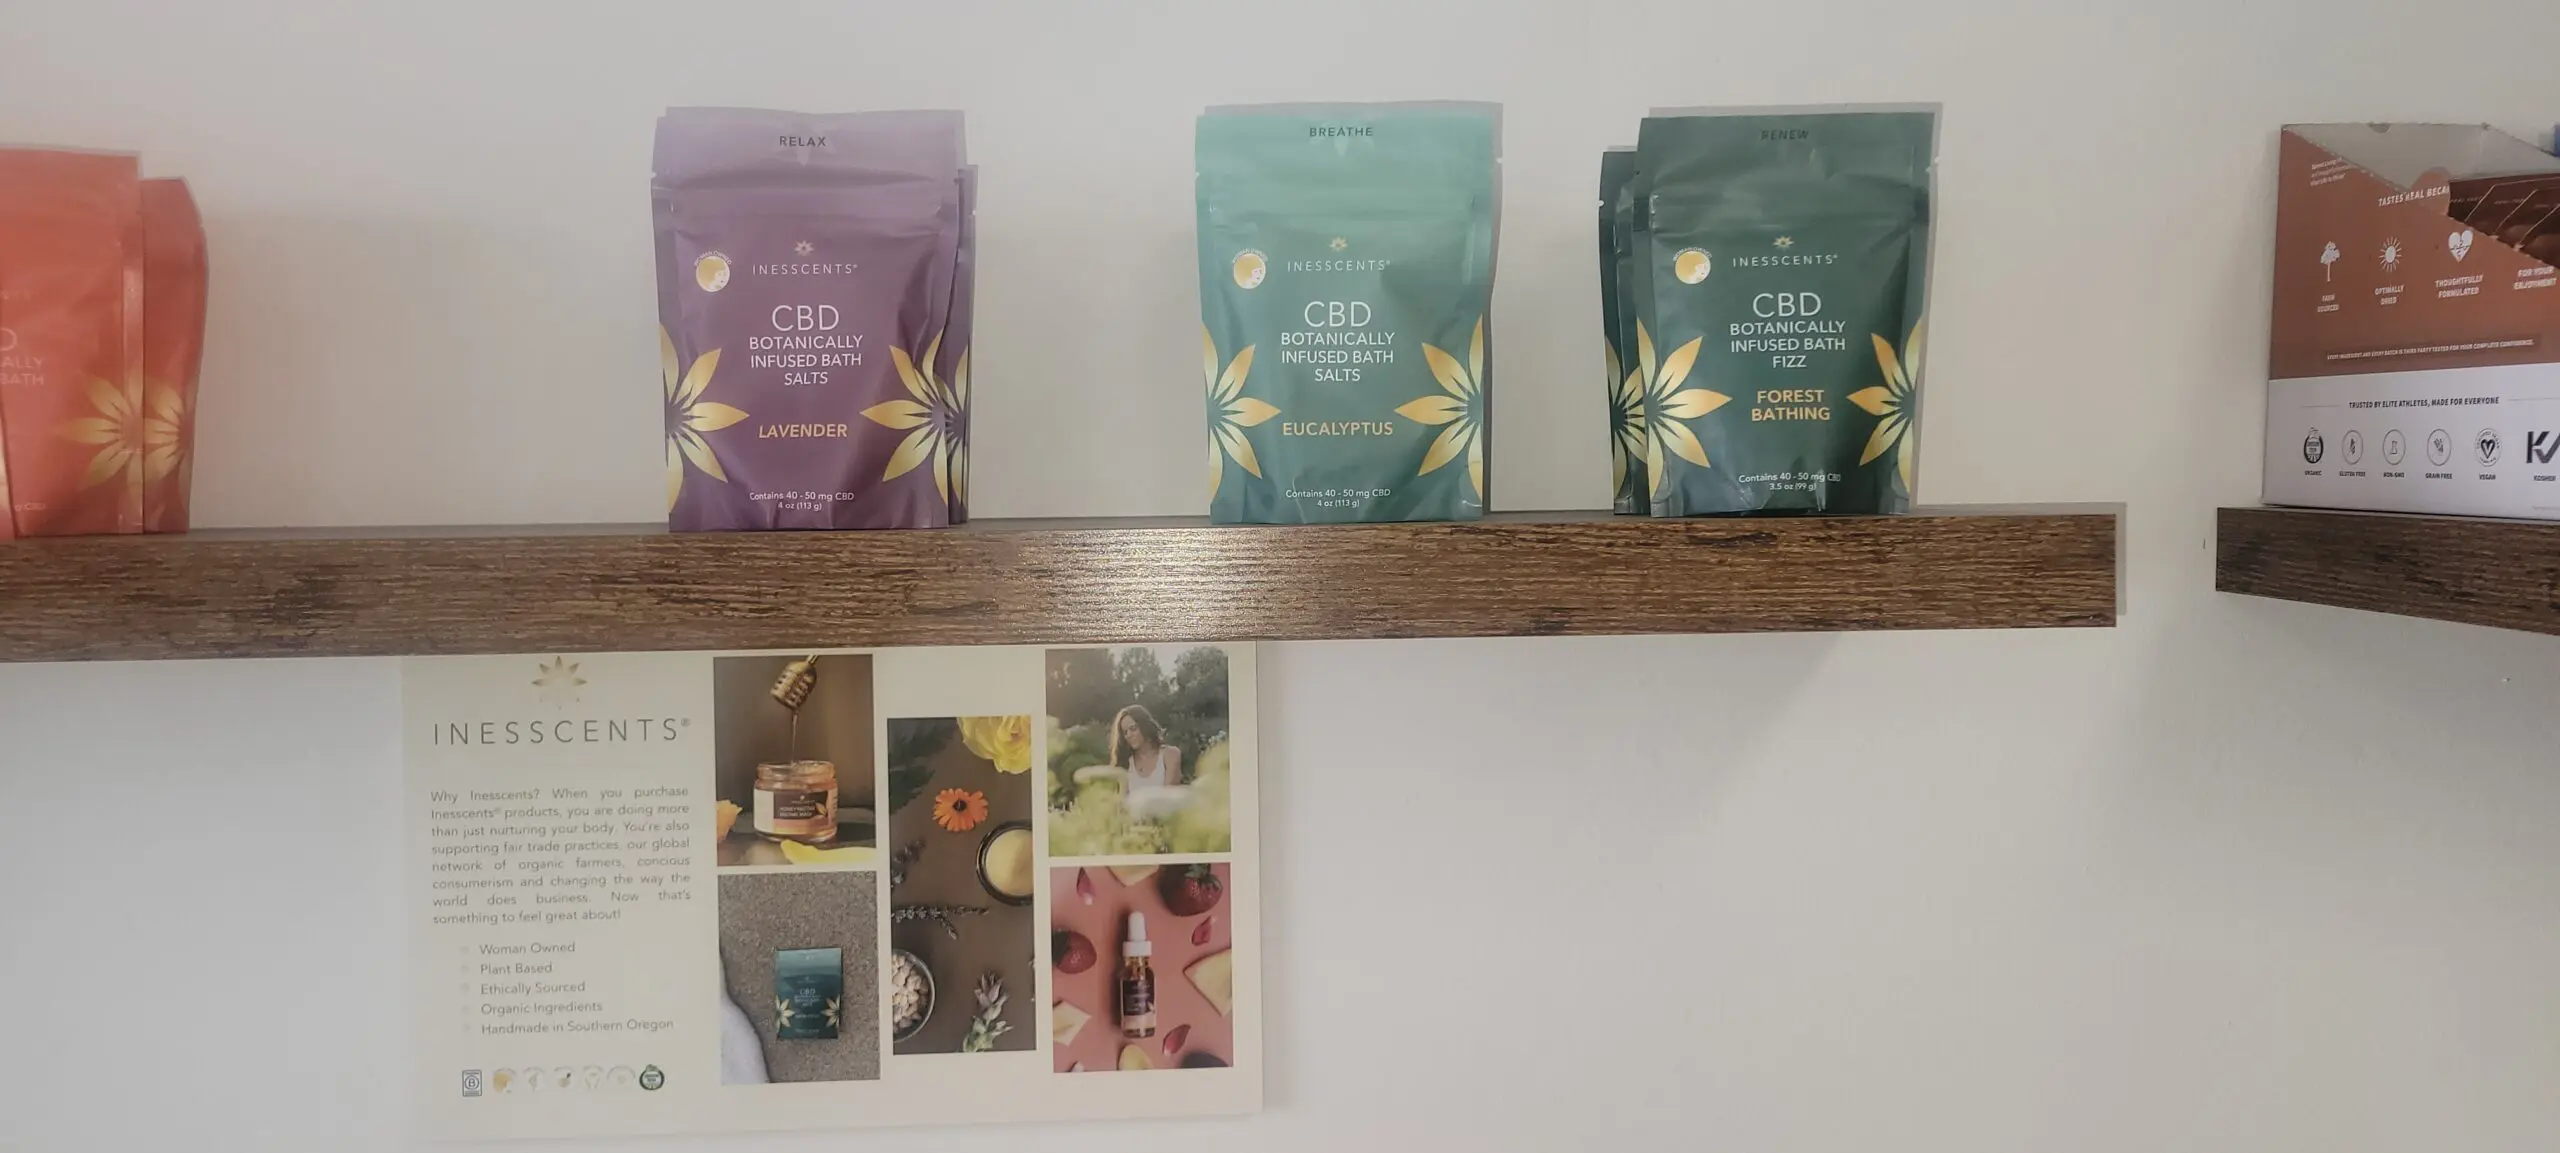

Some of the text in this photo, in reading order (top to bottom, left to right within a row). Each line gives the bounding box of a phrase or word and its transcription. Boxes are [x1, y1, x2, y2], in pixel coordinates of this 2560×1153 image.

[1310, 126, 1373, 137] BREATHE
[1761, 130, 1809, 140] RENEW
[779, 136, 826, 147] RELAX
[2378, 194, 2403, 207] TASTES
[2427, 185, 2449, 197] BECA
[2436, 274, 2483, 288] THOUGHTFULLY
[2375, 285, 2404, 295] OPTIMALLY
[2439, 287, 2479, 298] FORMULATED
[1753, 293, 1821, 317] CBD
[772, 305, 839, 331] CBD
[1304, 301, 1371, 327] CBD
[1730, 321, 1845, 335] BOTANICALLY
[749, 335, 863, 351] BOTANICALLY
[1281, 332, 1395, 346] BOTANICALLY
[1731, 338, 1845, 353] INFUSED BATH
[750, 353, 861, 368] INFUSED BATH
[1282, 351, 1393, 364] INFUSED BATH
[1773, 355, 1806, 368] FIZZ
[784, 372, 828, 386] SALTS
[1315, 369, 1360, 382] SALTS
[1757, 390, 1824, 403] FOREST
[2349, 401, 2373, 409] TRUSTED
[2382, 400, 2398, 408] ELITE
[2398, 399, 2430, 408] ATHLETES,
[2450, 398, 2462, 406] FOR
[2464, 397, 2499, 405] EVERYONE
[1752, 407, 1830, 421] BATHING
[759, 424, 847, 439] LAVENDER
[1283, 422, 1393, 436] EUCALYPTUS
[1739, 475, 1777, 483] Contains
[749, 491, 854, 503] Contains 40 50 mg CBD
[1286, 489, 1390, 500] Contains 40 50 mg CBD
[1335, 499, 1349, 508] (113
[1351, 499, 1360, 508] g)
[430, 786, 688, 804] Why Inesscents? When you purchase
[504, 806, 562, 820] products,
[568, 807, 589, 818] you
[595, 806, 613, 816] are
[618, 804, 653, 817] doing
[658, 805, 689, 814] more
[431, 825, 458, 837] than
[462, 824, 484, 839] just
[490, 824, 546, 838] nurturing
[552, 824, 578, 836] your
[624, 821, 660, 832] You're
[666, 822, 689, 831] also
[432, 842, 498, 856] supporting
[504, 842, 522, 853] fair
[528, 841, 560, 852] trade
[627, 840, 646, 850] our
[652, 838, 690, 851] global
[432, 859, 482, 871] network
[494, 859, 506, 870] of
[518, 858, 564, 871] organic
[432, 872, 691, 889] consumerism and changing the way the
[433, 894, 468, 906] world
[487, 894, 517, 905] does
[611, 891, 639, 902] Now
[658, 890, 691, 900] that's
[433, 908, 621, 925] something to feel great about!
[480, 942, 576, 955] Woman Owned
[480, 962, 552, 975] Plant Based
[480, 981, 586, 996] Ethically Sourced
[481, 1001, 603, 1016] Organic Ingredients
[482, 1018, 674, 1034] Handmade in Southern Oregon
